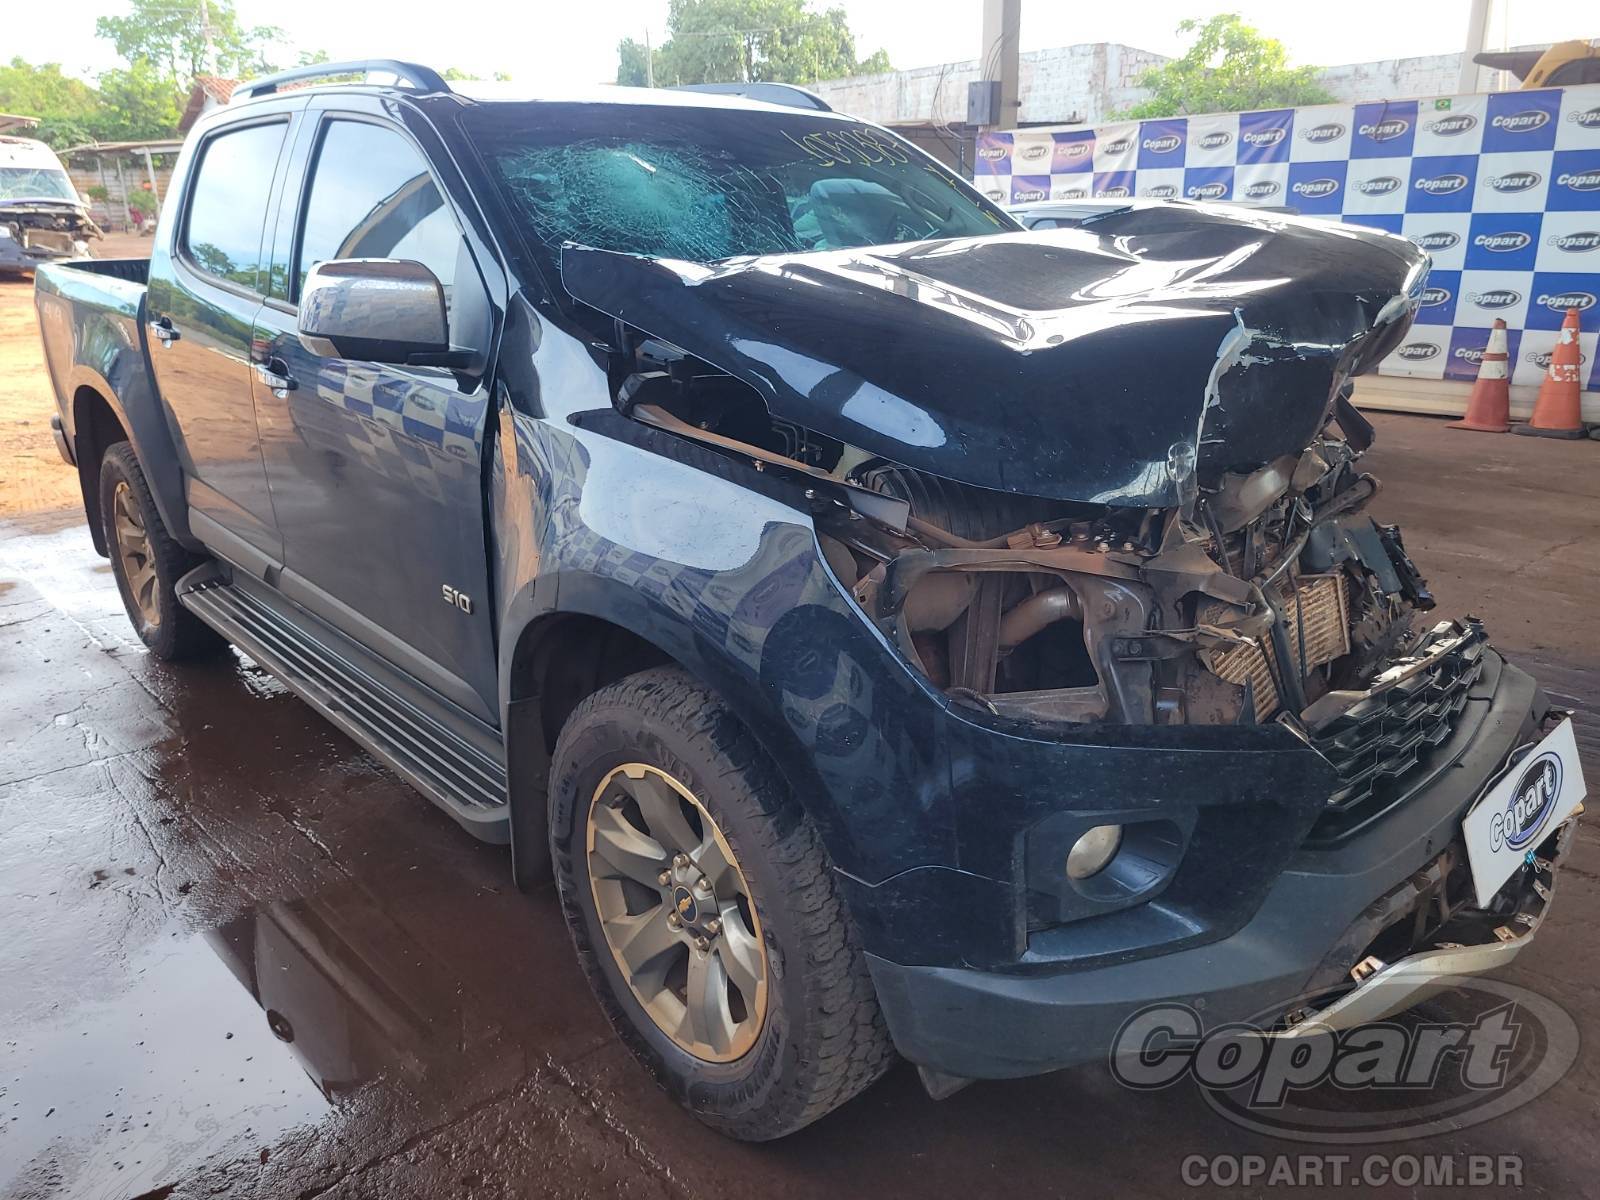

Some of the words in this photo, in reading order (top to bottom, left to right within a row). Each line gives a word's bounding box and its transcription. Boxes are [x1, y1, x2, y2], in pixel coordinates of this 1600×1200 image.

[1422, 118, 1468, 132] Copart
[1492, 113, 1542, 128] Copart
[1298, 127, 1339, 141] Copart
[1359, 121, 1402, 136] Copart
[1243, 130, 1282, 144] Copart
[1143, 139, 1177, 151] Copart
[1240, 180, 1277, 194] Copart
[1292, 179, 1333, 193] Copart
[1352, 179, 1396, 191] Copart
[1414, 178, 1461, 191] Copart
[1482, 175, 1534, 188] Copart
[1556, 173, 1600, 187] Copar
[1014, 191, 1042, 201] Copart
[1188, 186, 1222, 198] Copart
[1474, 233, 1523, 247] Copart
[1547, 235, 1600, 248] Copart
[1465, 291, 1514, 305] Copart
[1536, 294, 1591, 308] Copart
[1398, 345, 1434, 356] opart
[1455, 347, 1482, 360] Cop
[1526, 352, 1552, 364] Cop
[442, 584, 471, 614] S10
[1490, 762, 1555, 853] Copart
